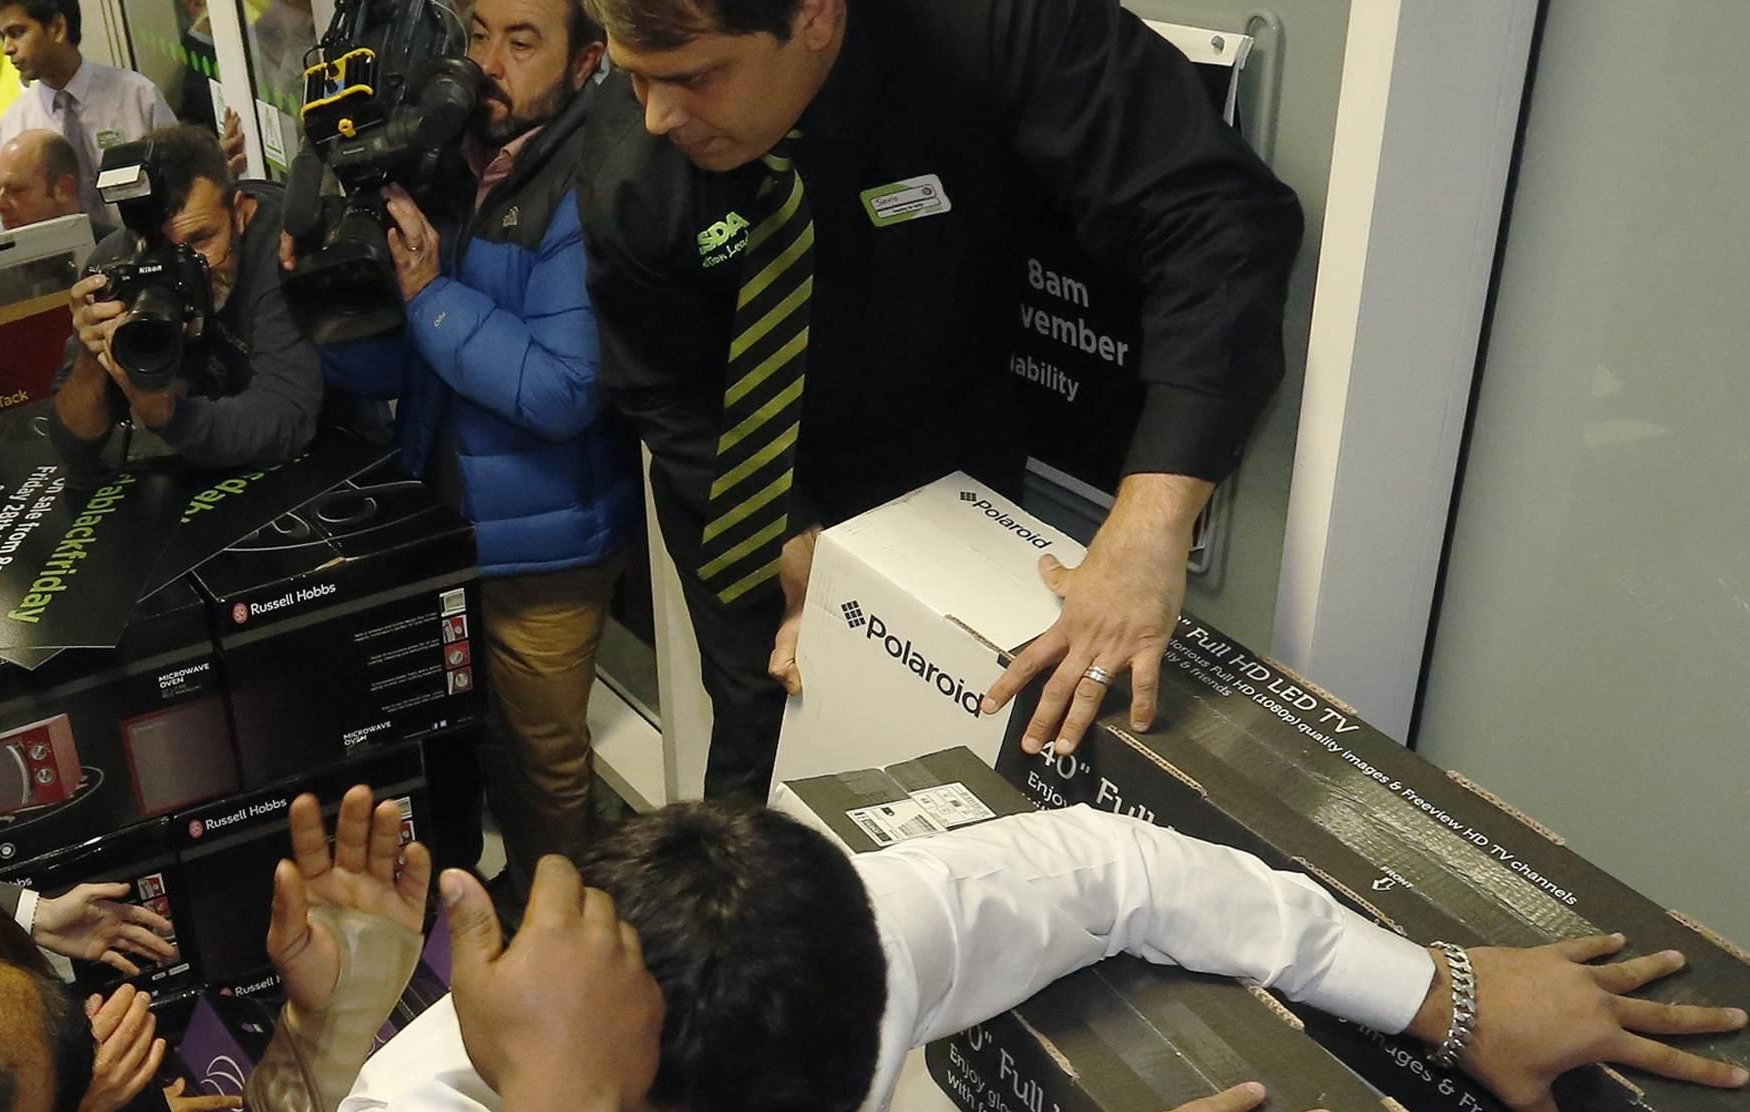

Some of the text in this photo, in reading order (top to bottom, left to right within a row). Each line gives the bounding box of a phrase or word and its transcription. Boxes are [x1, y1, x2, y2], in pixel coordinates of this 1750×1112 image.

[697, 210, 750, 256] SDA
[139, 264, 162, 275] Nikon
[1027, 257, 1089, 309] 8am
[1020, 303, 1129, 367] vember
[9, 466, 58, 501] Friday
[25, 495, 56, 520] sale
[971, 498, 1054, 550] Polaroid
[250, 581, 337, 616] Russell Hobbs
[158, 662, 210, 683] MICROWAVE
[159, 676, 185, 688] OVEN
[866, 613, 987, 719] Polaroid
[1186, 626, 1359, 735] Full HD LED TV
[1190, 667, 1232, 697] friends
[1169, 638, 1577, 906] lorious Full HD (1080p) quality images & Freeview HD TV channels
[205, 797, 288, 831] Russell Hobbs
[1381, 865, 1415, 890] FRONT
[234, 976, 274, 998] Russell
[950, 1042, 986, 1093] Enjoy
[947, 1069, 976, 1109] with
[1438, 1078, 1456, 1096] &
